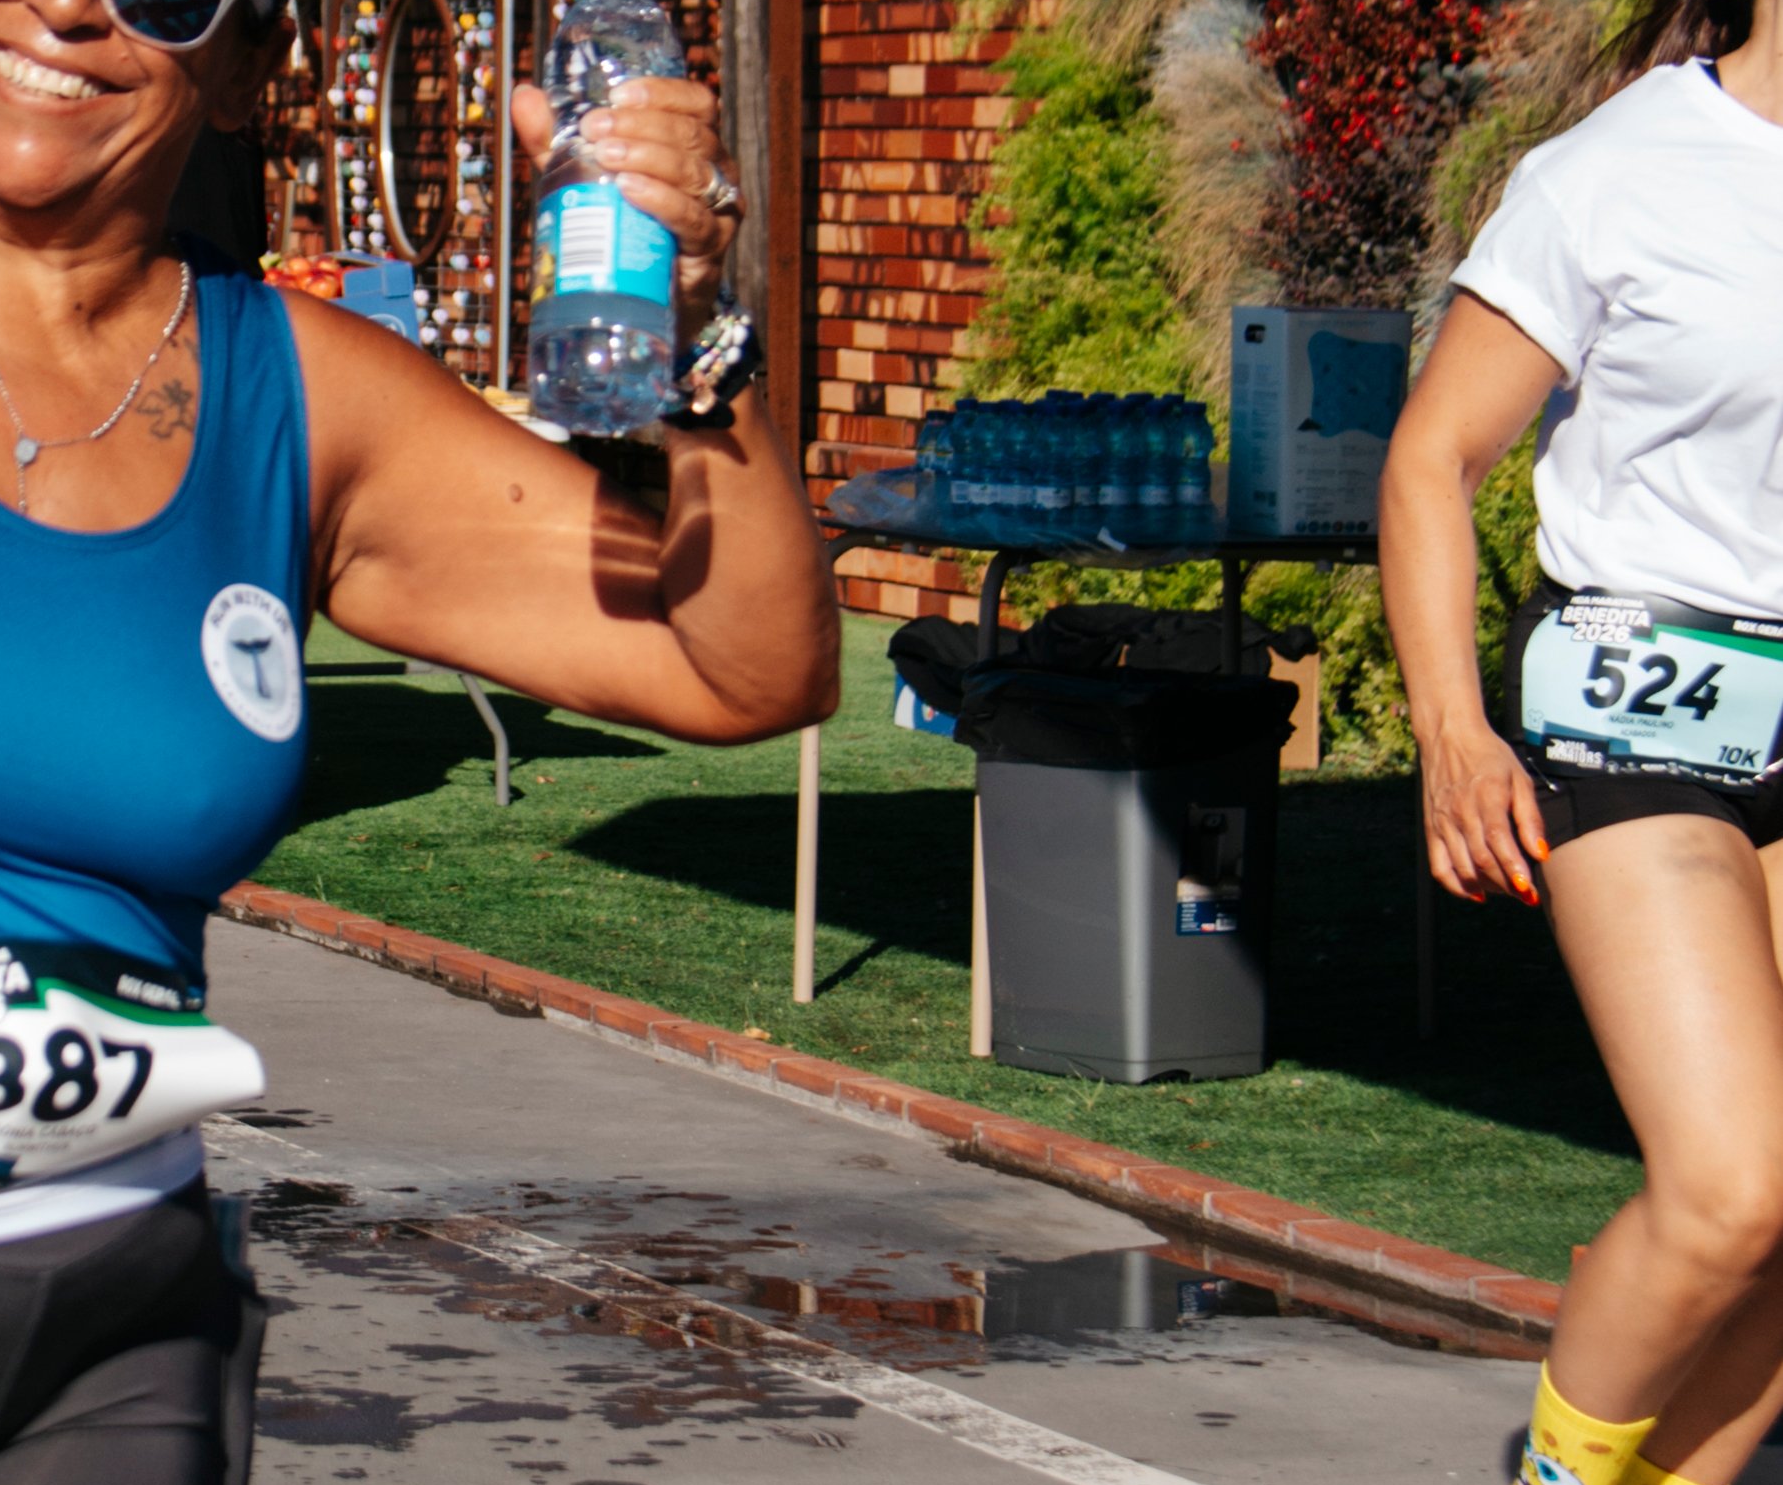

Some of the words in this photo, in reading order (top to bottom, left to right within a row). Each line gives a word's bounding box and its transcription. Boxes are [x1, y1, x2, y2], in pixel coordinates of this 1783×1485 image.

[1560, 605, 1652, 629] BENEDITA
[1733, 619, 1757, 633] BOX
[1571, 622, 1632, 643] 2026
[1582, 644, 1726, 721] 524
[1717, 745, 1761, 768] 10K
